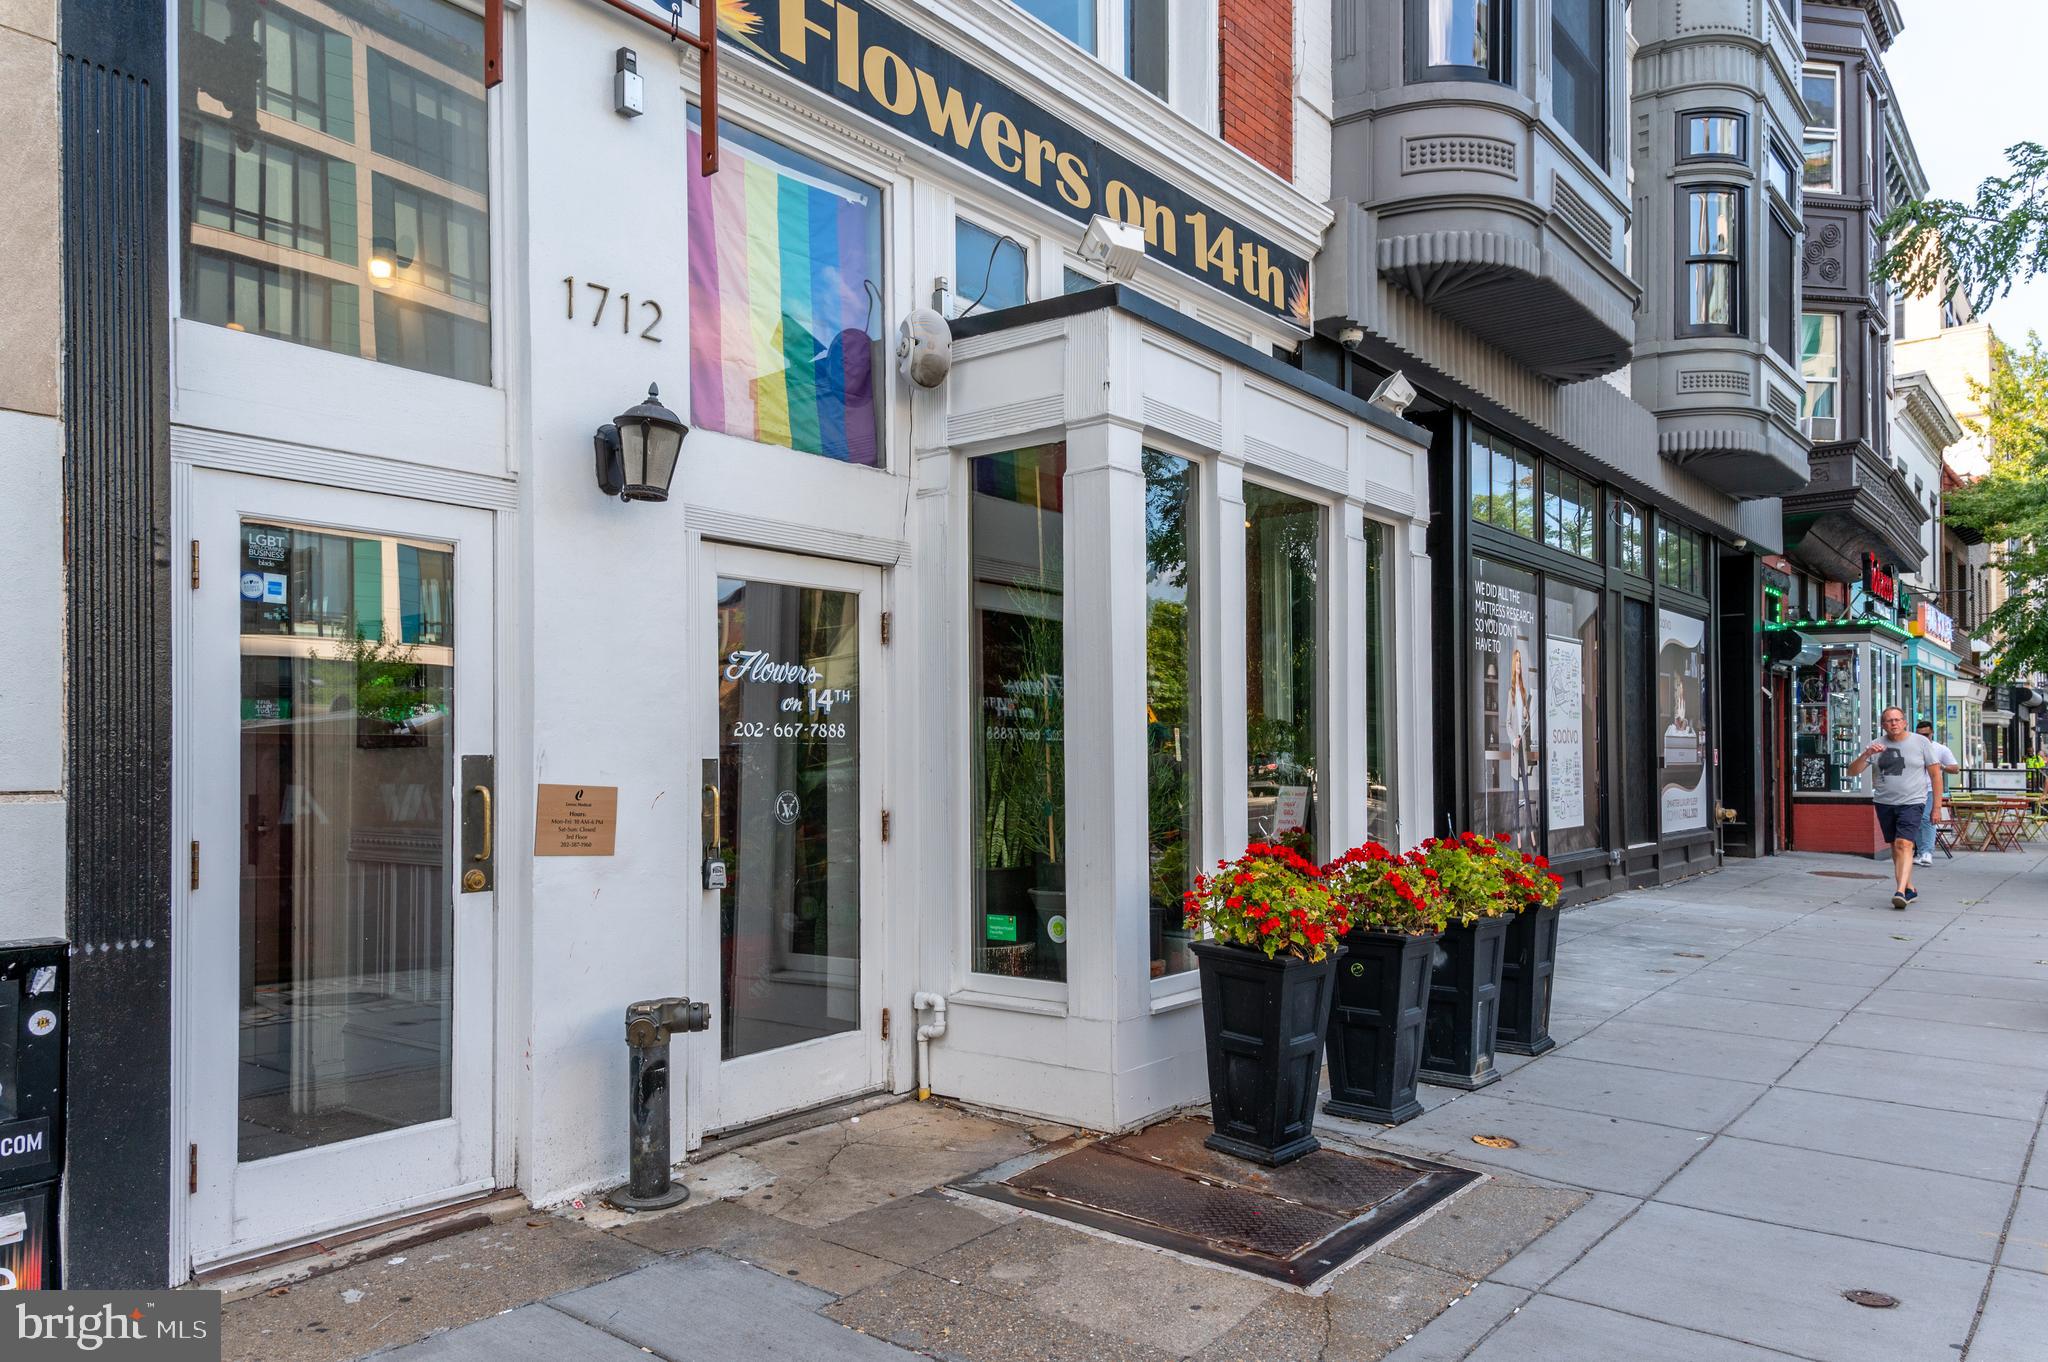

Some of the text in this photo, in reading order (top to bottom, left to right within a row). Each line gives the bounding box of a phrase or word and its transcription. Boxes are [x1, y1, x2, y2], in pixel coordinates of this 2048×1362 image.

[778, 0, 1285, 310] Flowers on 14th
[564, 276, 662, 342] 1712
[249, 533, 285, 547] LGBT
[249, 548, 285, 559] BUSINESS
[1475, 580, 1520, 604] WE DID ALL THE
[1475, 599, 1534, 624] MATTRESS RESEARCH
[1475, 618, 1484, 632] SO
[1485, 619, 1498, 634] YOU
[1475, 637, 1501, 653] HAVE TO
[724, 650, 823, 683] Flowers
[780, 697, 802, 712] on
[1552, 728, 1578, 744] saatva
